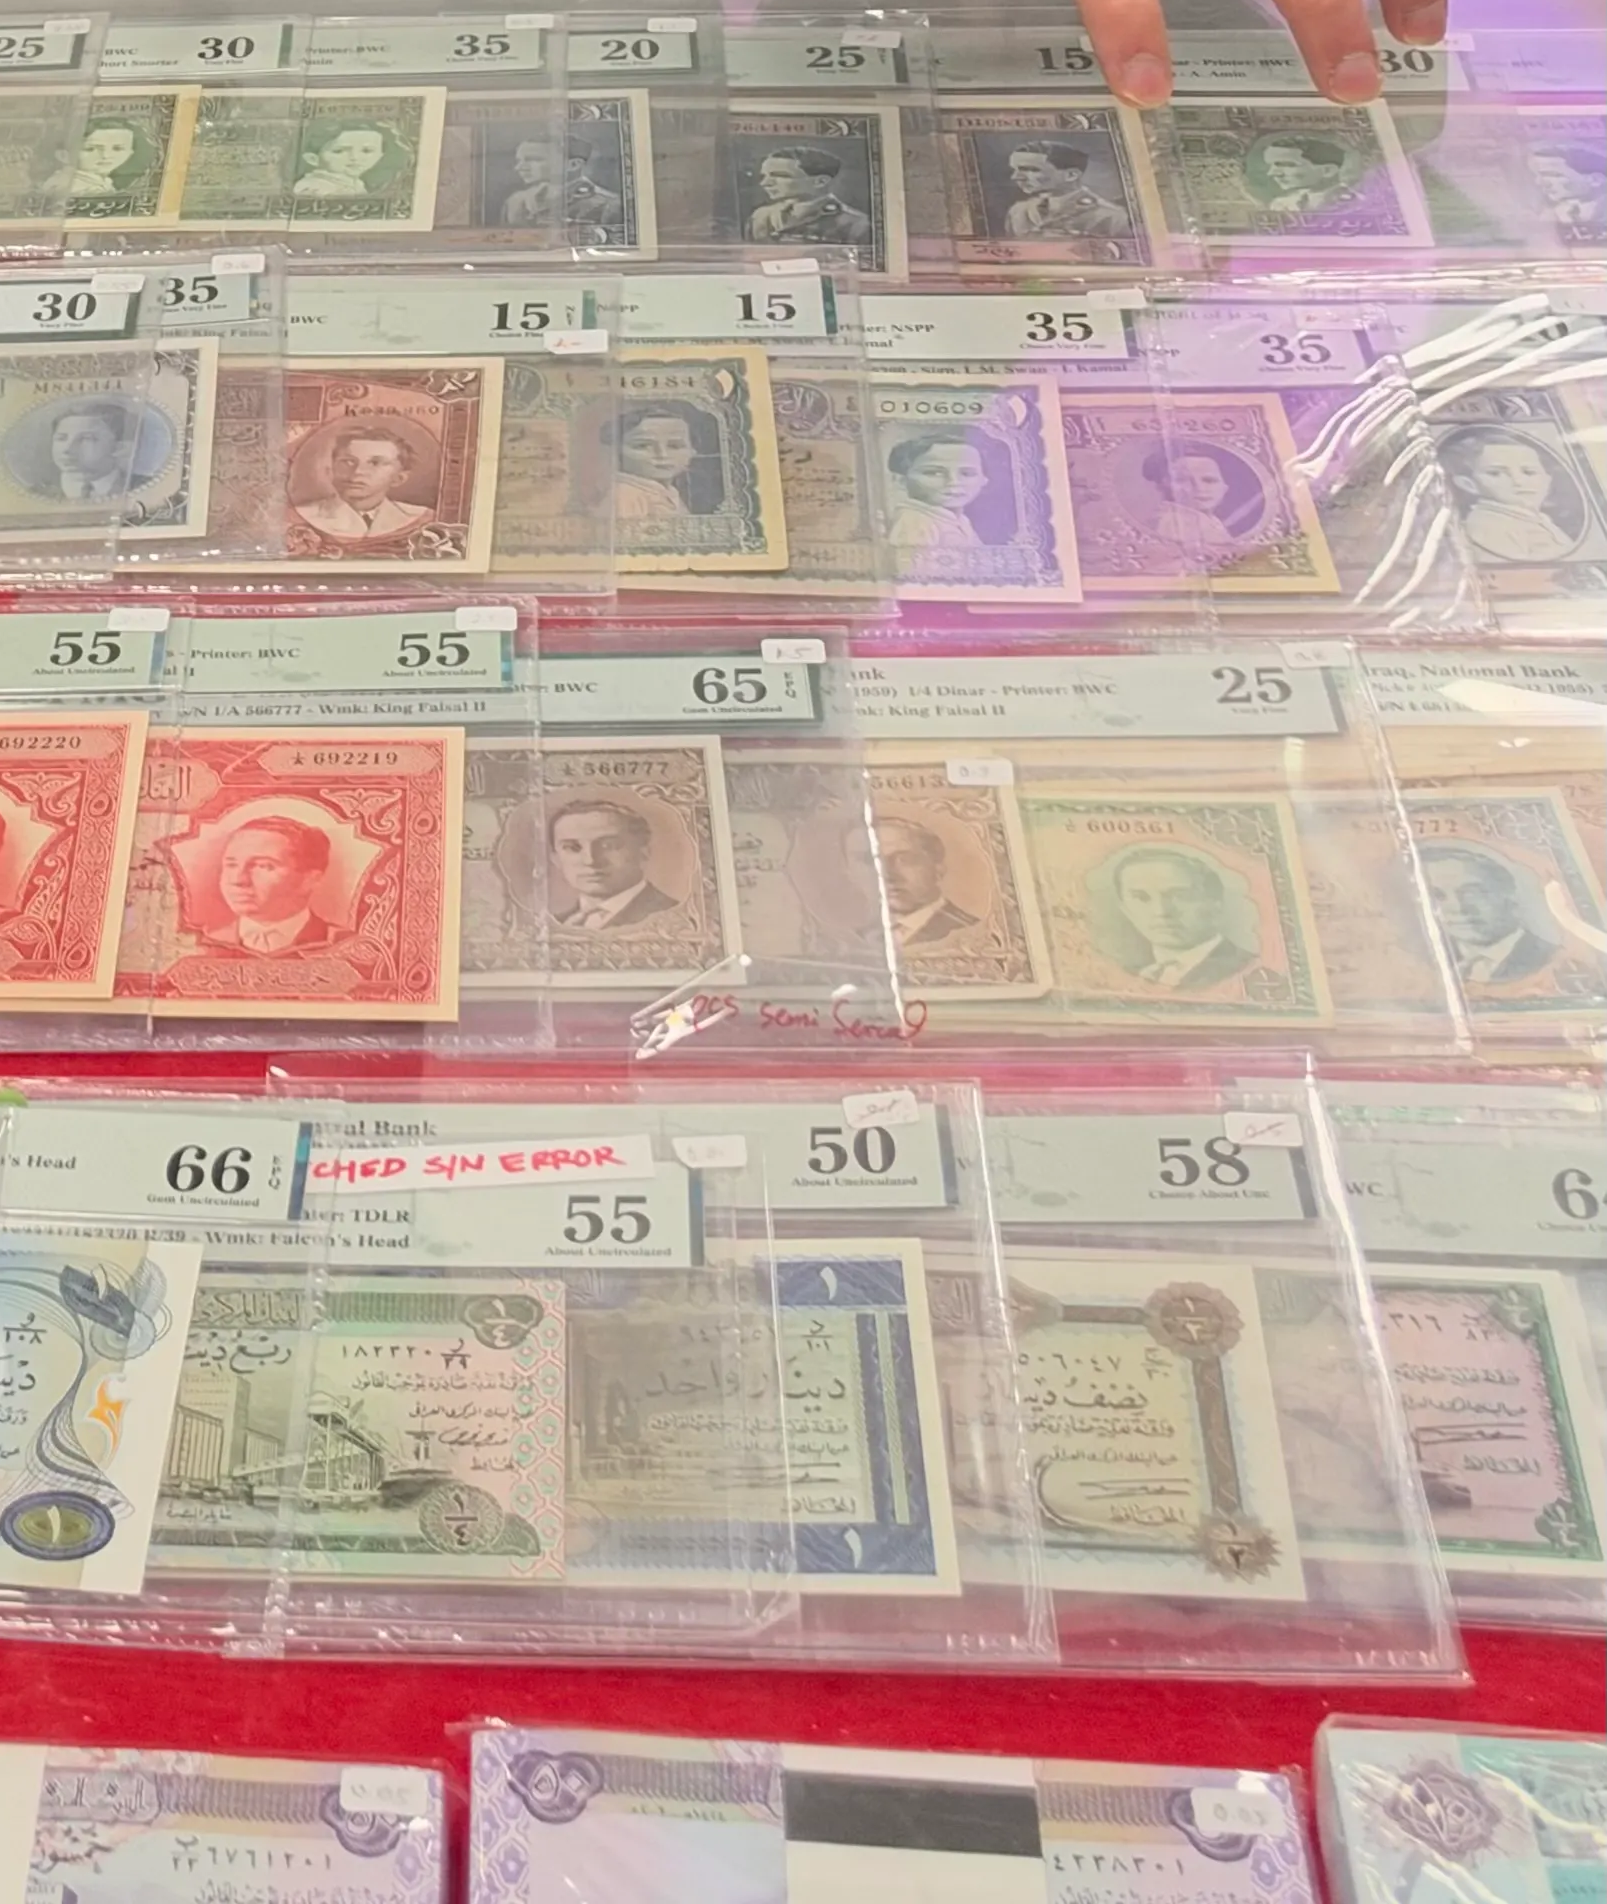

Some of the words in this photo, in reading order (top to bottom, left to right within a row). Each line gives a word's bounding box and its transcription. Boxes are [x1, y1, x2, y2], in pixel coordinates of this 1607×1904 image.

[197, 36, 255, 60] 30
[452, 33, 512, 58] 35
[600, 38, 660, 62] 20
[805, 45, 866, 69] 25
[1036, 46, 1093, 72] 15
[1378, 48, 1434, 73] 30
[161, 274, 220, 306] 35
[32, 292, 98, 323] 30
[490, 301, 551, 331] 15
[736, 293, 797, 322] 15
[1025, 311, 1094, 342] 35
[1258, 332, 1333, 365] 35
[880, 399, 984, 415] 010609
[49, 630, 123, 667] 55
[190, 648, 254, 661] Printer:
[257, 648, 301, 659] BWC
[396, 632, 472, 668] 55
[1421, 663, 1512, 679] National
[1518, 664, 1581, 679] Bank
[554, 682, 599, 694] BWC
[692, 667, 768, 705] 65
[936, 684, 986, 697] Dinar
[1002, 684, 1067, 697] Printer:
[1211, 666, 1294, 705] 25
[244, 703, 303, 717] 566777
[318, 702, 367, 716] Wmk:
[372, 701, 414, 717] King
[418, 700, 468, 714] Faisal
[888, 704, 931, 719] King
[935, 703, 987, 717] Faisal
[312, 750, 399, 766] 692219
[583, 760, 670, 776] 566777
[1086, 819, 1176, 835] 600561
[373, 1119, 438, 1137] Bank
[27, 1154, 78, 1171] Head
[423, 1153, 486, 1180] S/N
[499, 1145, 626, 1174] ERROR
[806, 1125, 897, 1175] 50
[1156, 1136, 1251, 1188] 58
[165, 1143, 253, 1193] 66
[351, 1207, 410, 1225] TDLR
[561, 1195, 653, 1245] 55
[204, 1228, 266, 1245] Wmk:
[355, 1232, 410, 1249] Head
